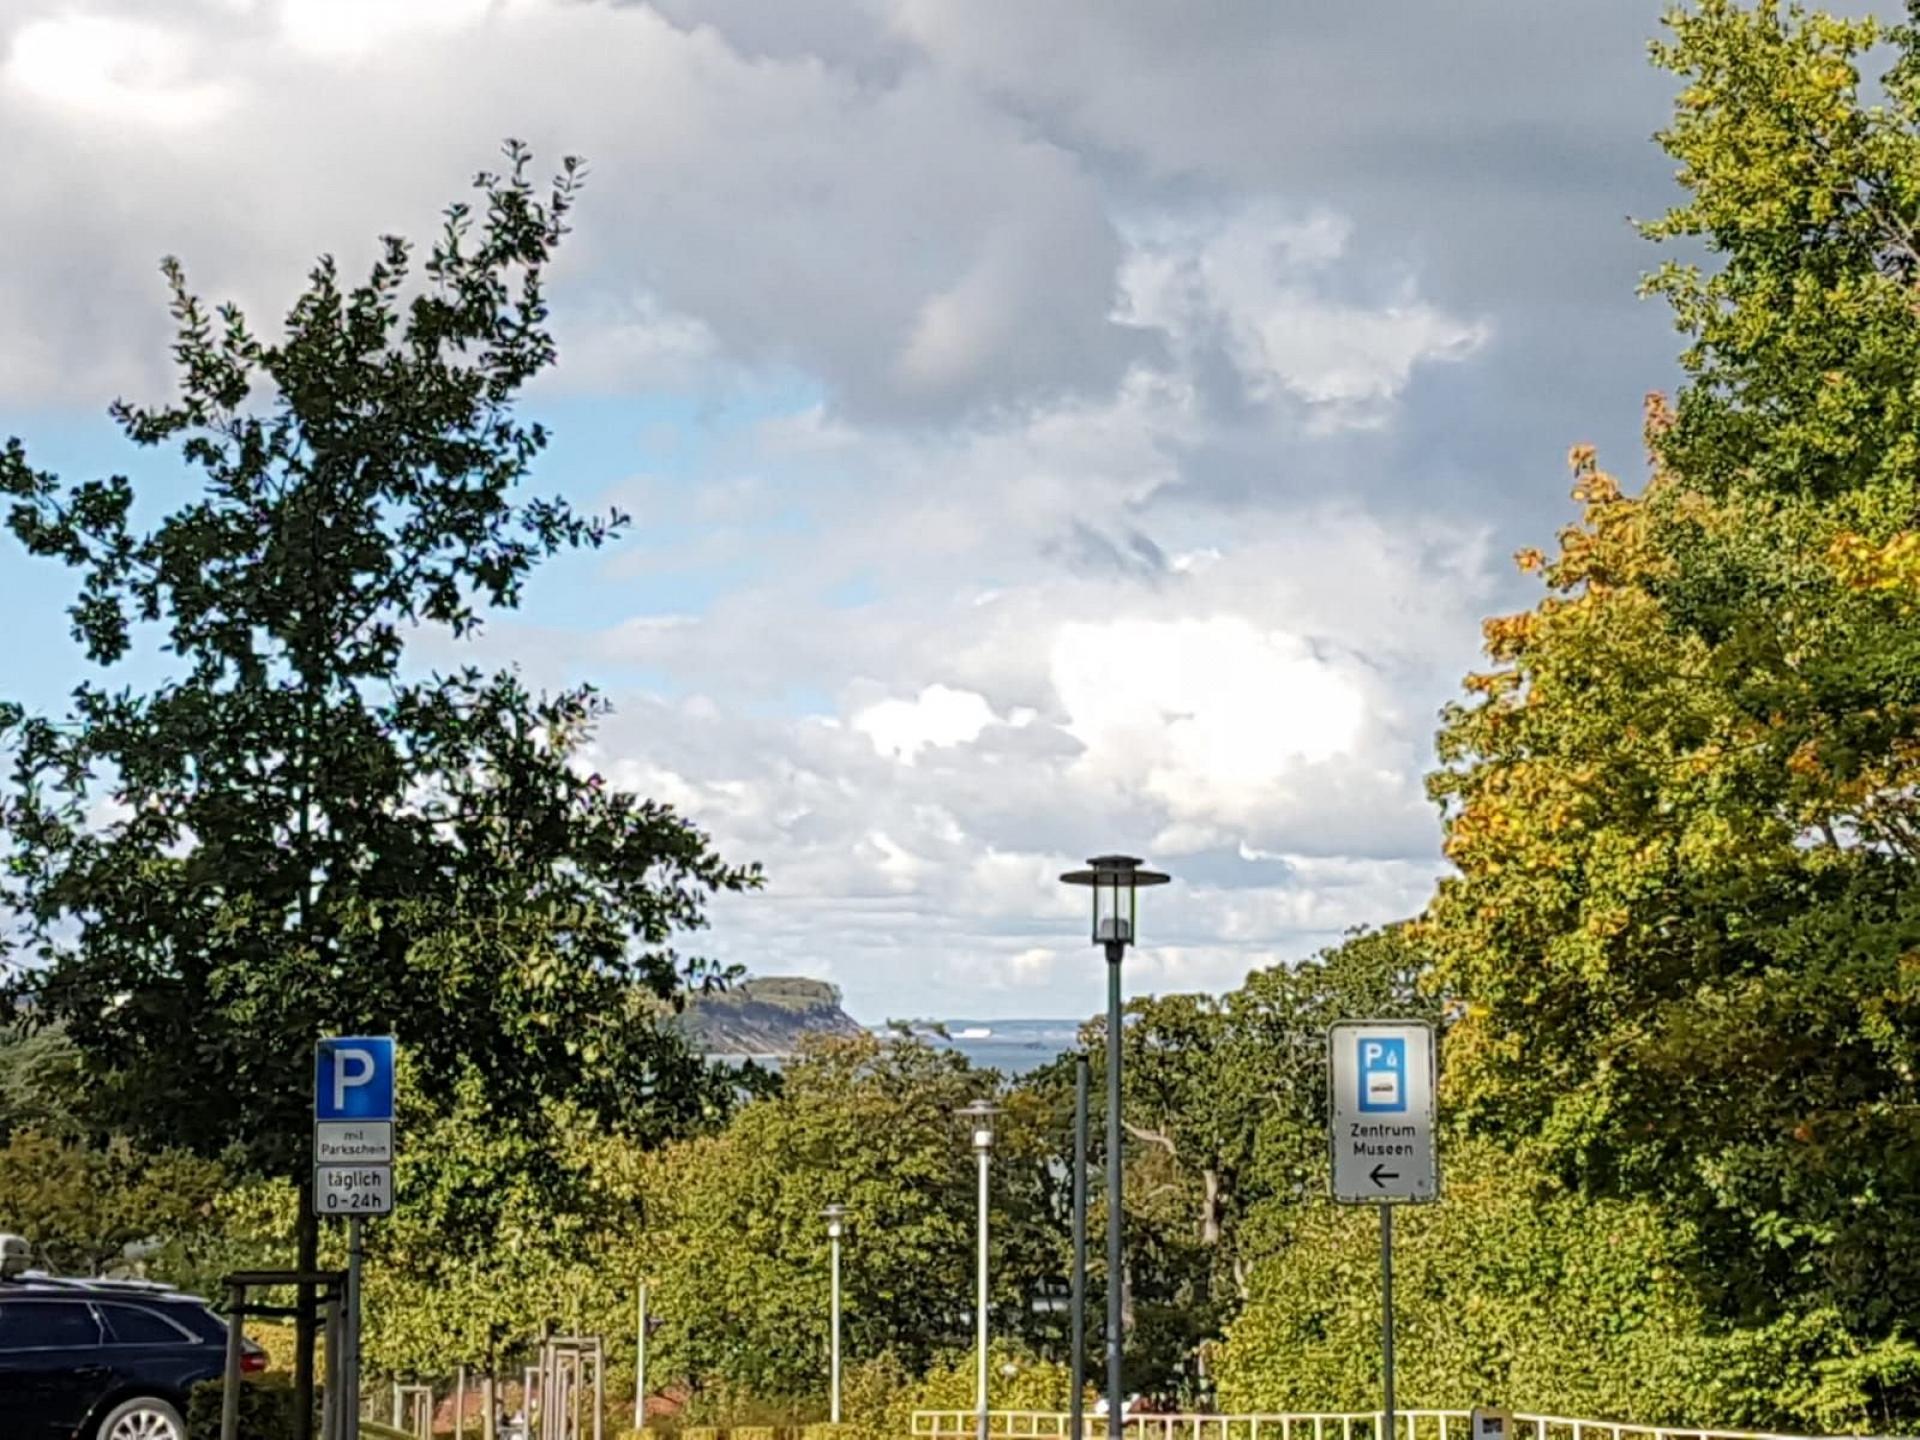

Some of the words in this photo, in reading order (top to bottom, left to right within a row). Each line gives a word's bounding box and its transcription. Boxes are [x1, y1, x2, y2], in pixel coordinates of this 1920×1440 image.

[1365, 1043, 1383, 1068] P
[334, 1049, 375, 1111] P
[344, 1130, 364, 1140] mit
[1350, 1122, 1416, 1138] Zentrum
[321, 1143, 386, 1155] Parkschein
[1353, 1142, 1414, 1156] Museen
[328, 1171, 381, 1190] täglich
